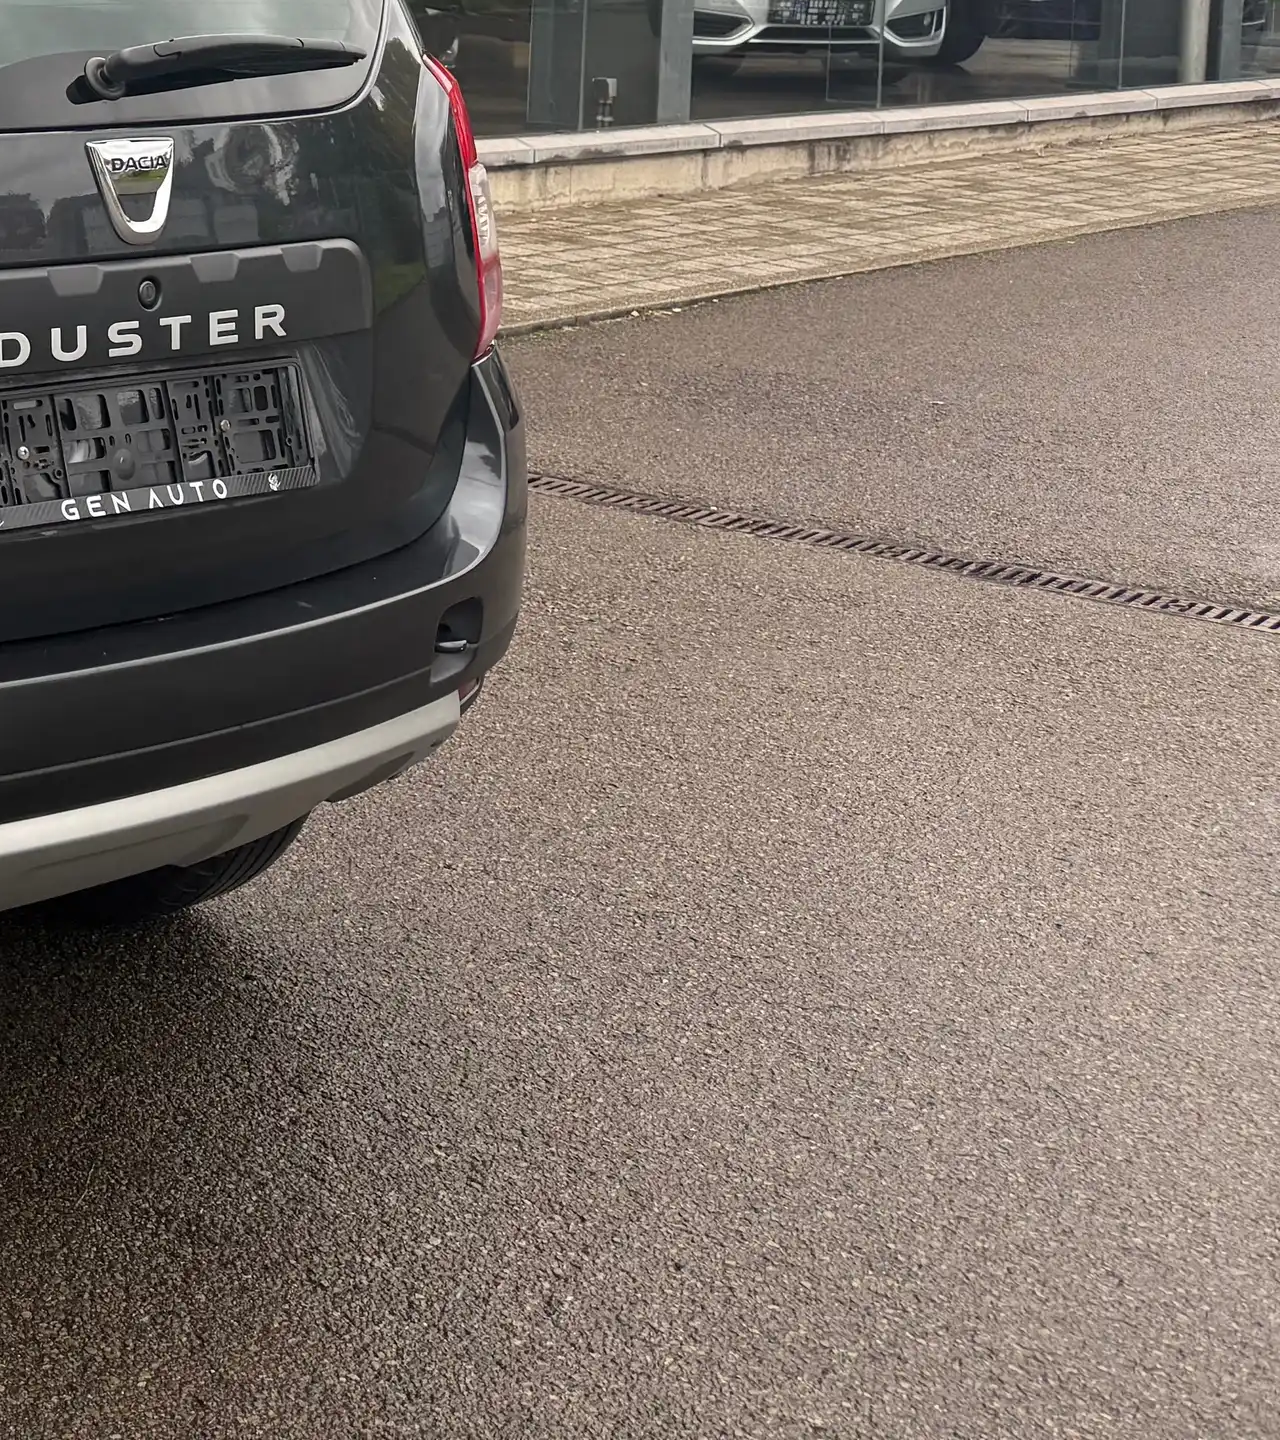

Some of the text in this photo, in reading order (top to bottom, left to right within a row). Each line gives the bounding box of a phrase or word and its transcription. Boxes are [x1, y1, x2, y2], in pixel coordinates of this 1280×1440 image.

[110, 155, 167, 172] DACIA
[60, 478, 228, 521] GEN AUTO
